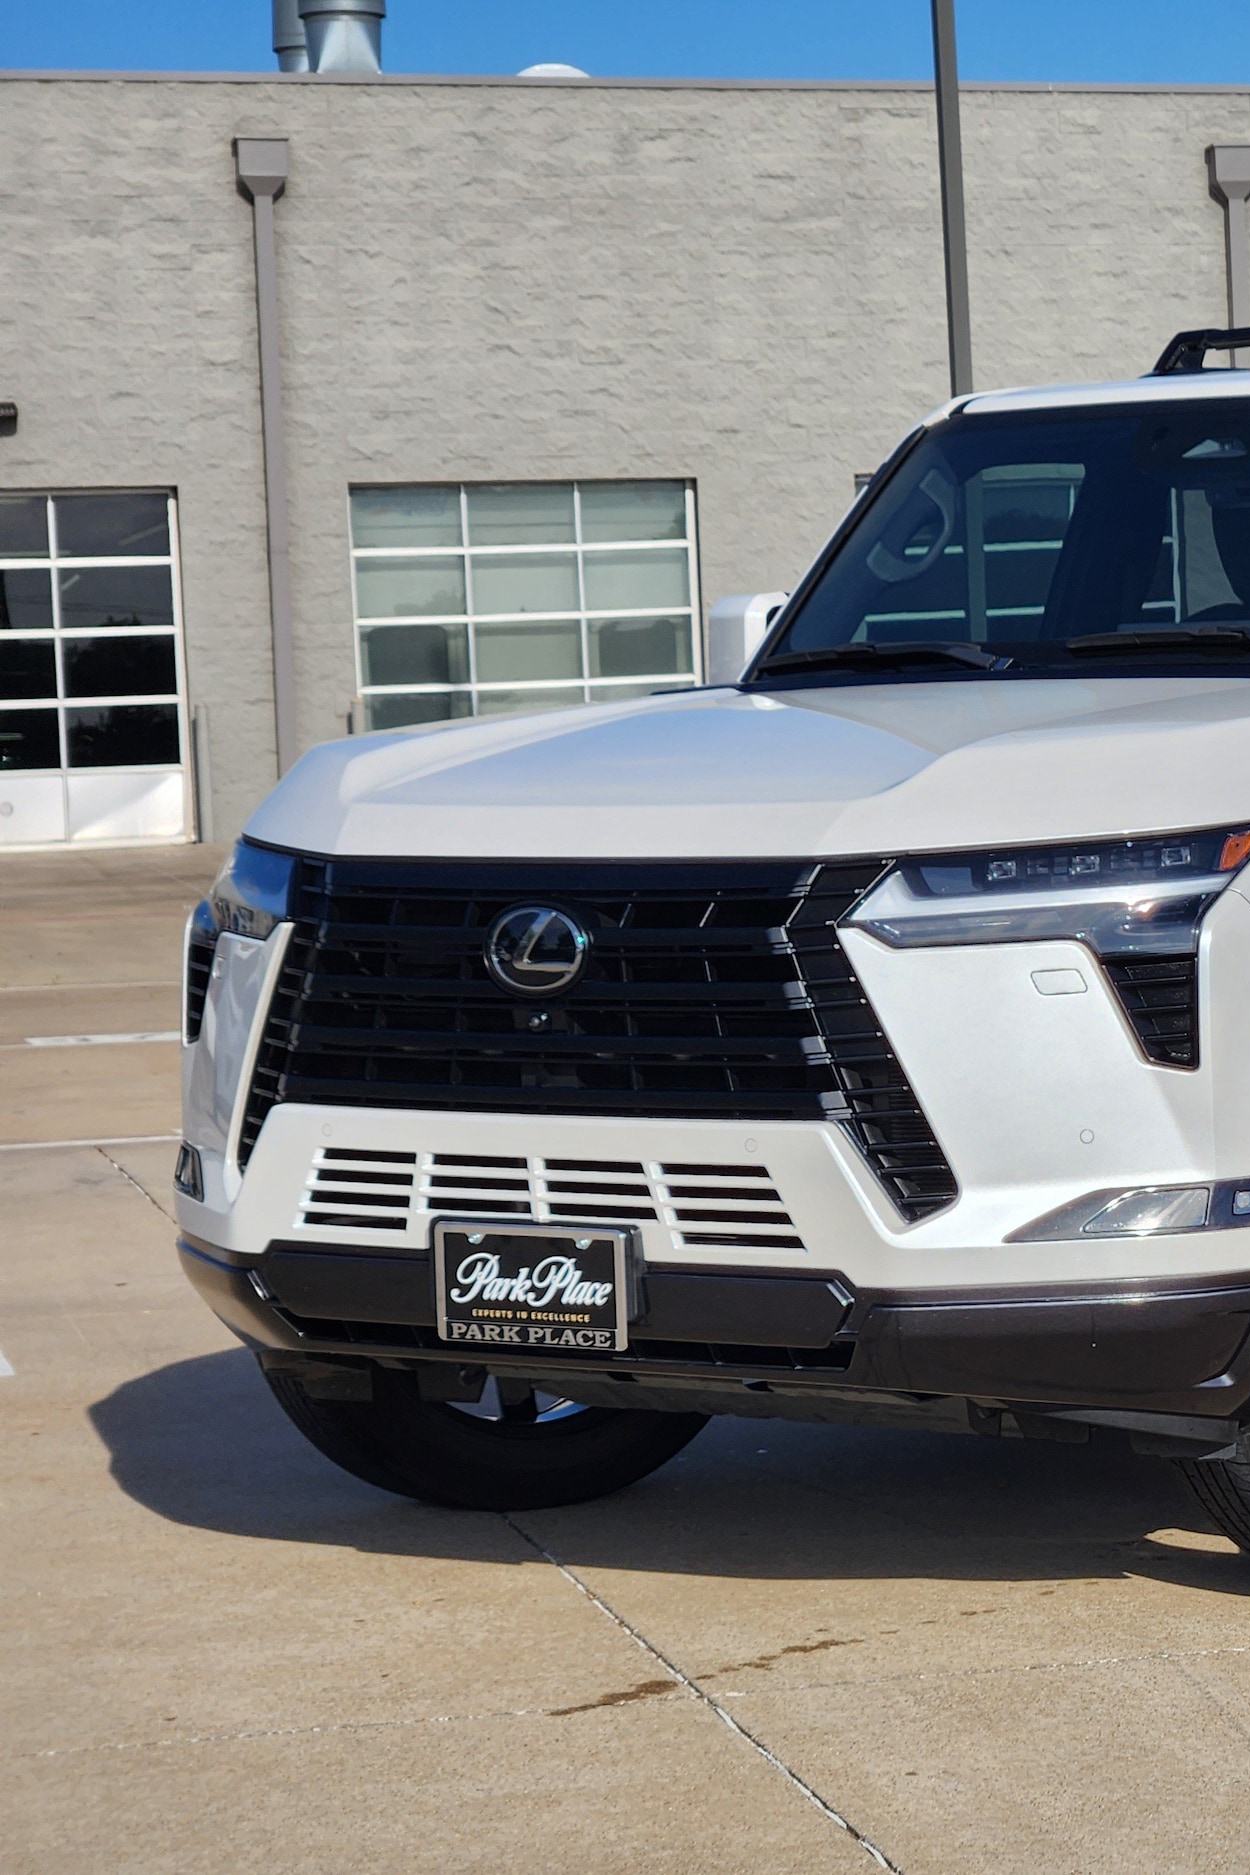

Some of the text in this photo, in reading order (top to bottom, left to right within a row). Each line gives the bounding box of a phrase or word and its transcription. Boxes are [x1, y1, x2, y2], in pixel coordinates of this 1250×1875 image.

[450, 1252, 614, 1308] Park Place
[471, 1308, 591, 1324] EXPERTS IN EXCELLENCE
[450, 1322, 612, 1348] PARK PLACE
